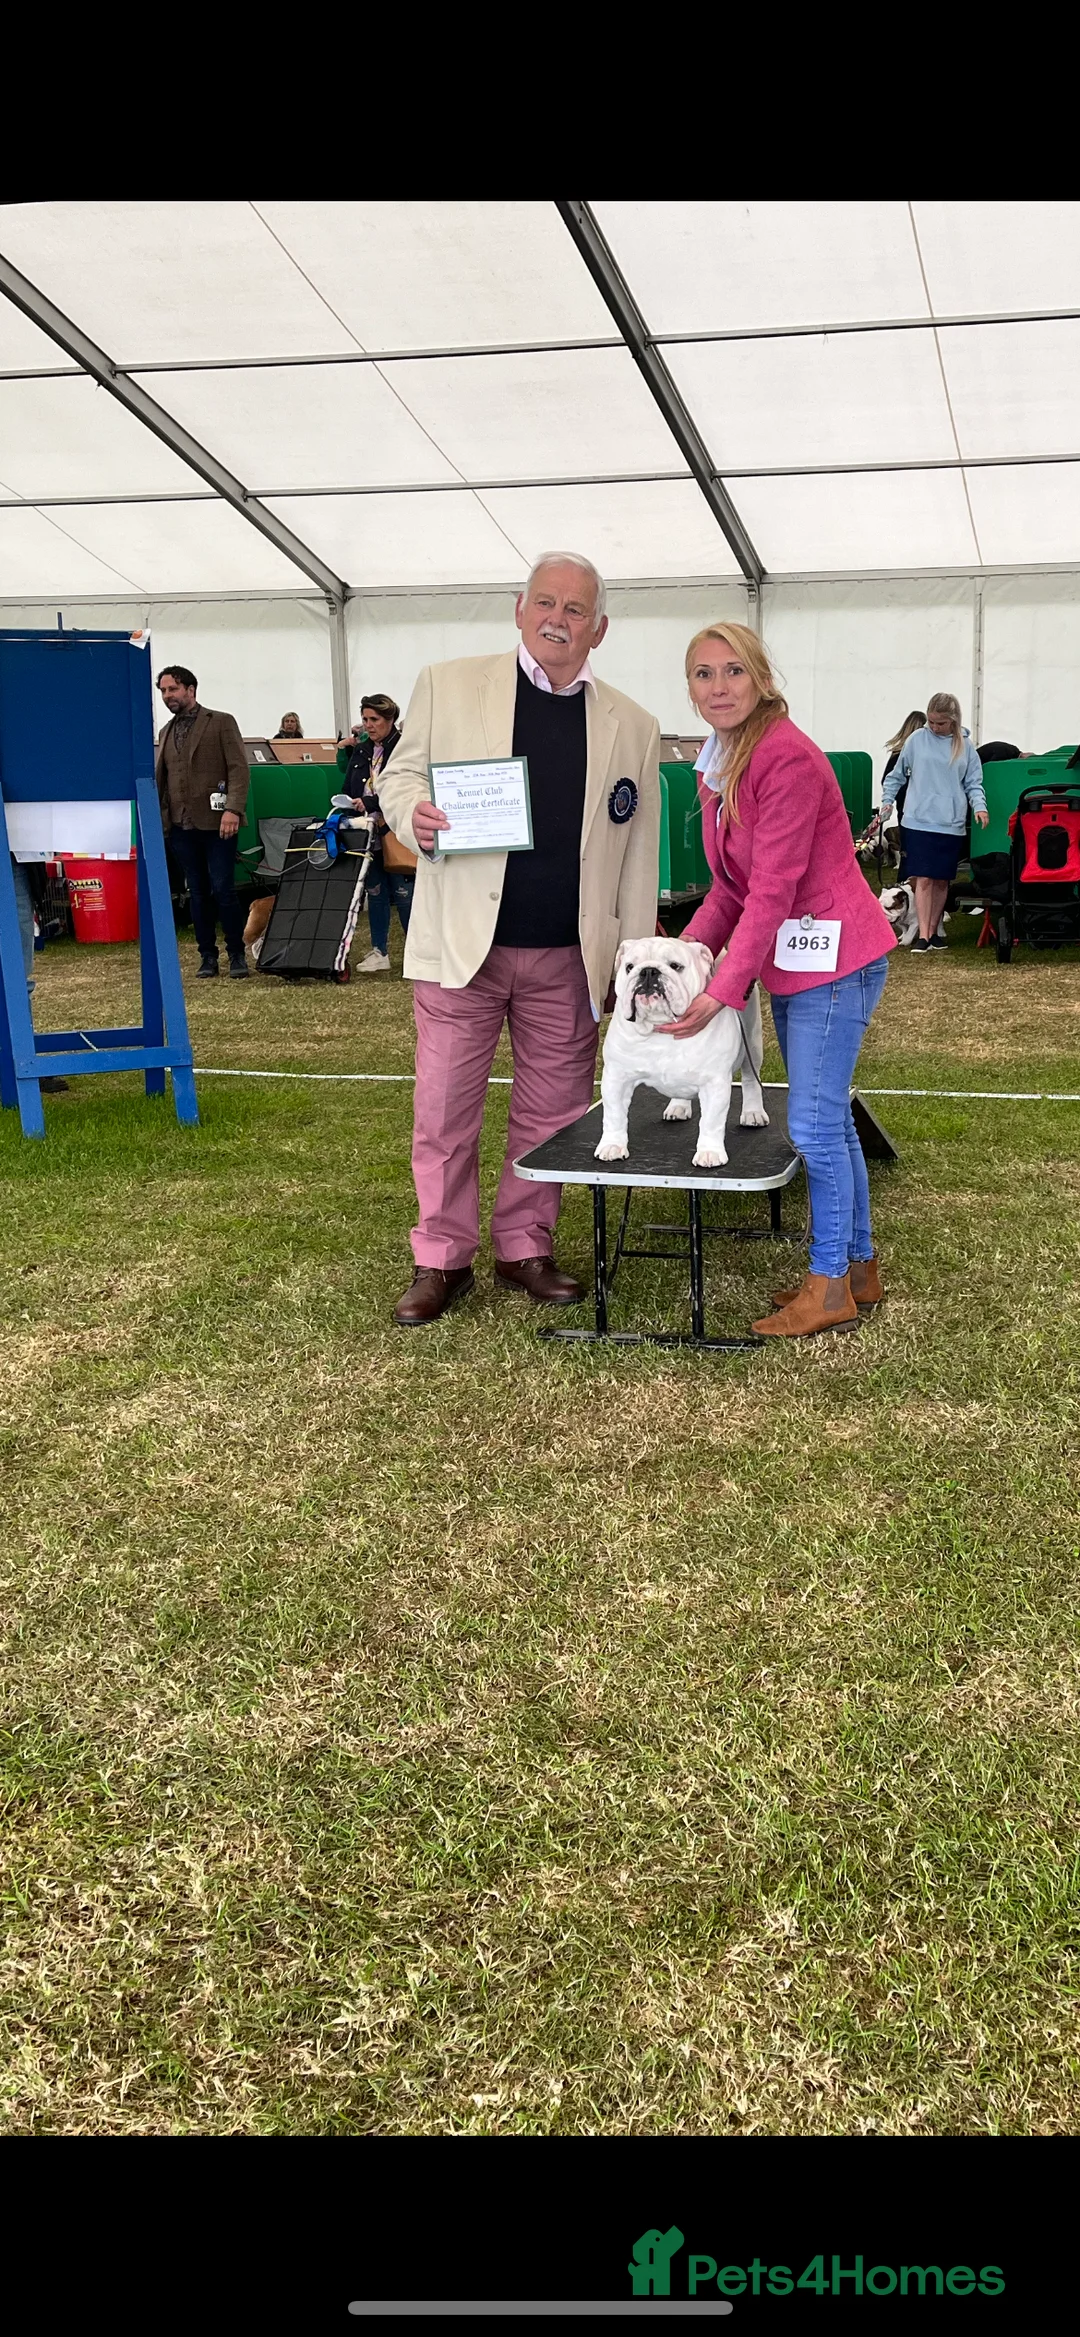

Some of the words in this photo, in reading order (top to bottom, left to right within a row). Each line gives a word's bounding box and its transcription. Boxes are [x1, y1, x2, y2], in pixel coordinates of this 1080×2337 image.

[456, 788, 483, 798] Kennel
[484, 786, 503, 796] Club
[441, 801, 480, 811] Challenge
[481, 798, 521, 808] Certificate
[787, 936, 830, 950] 4963
